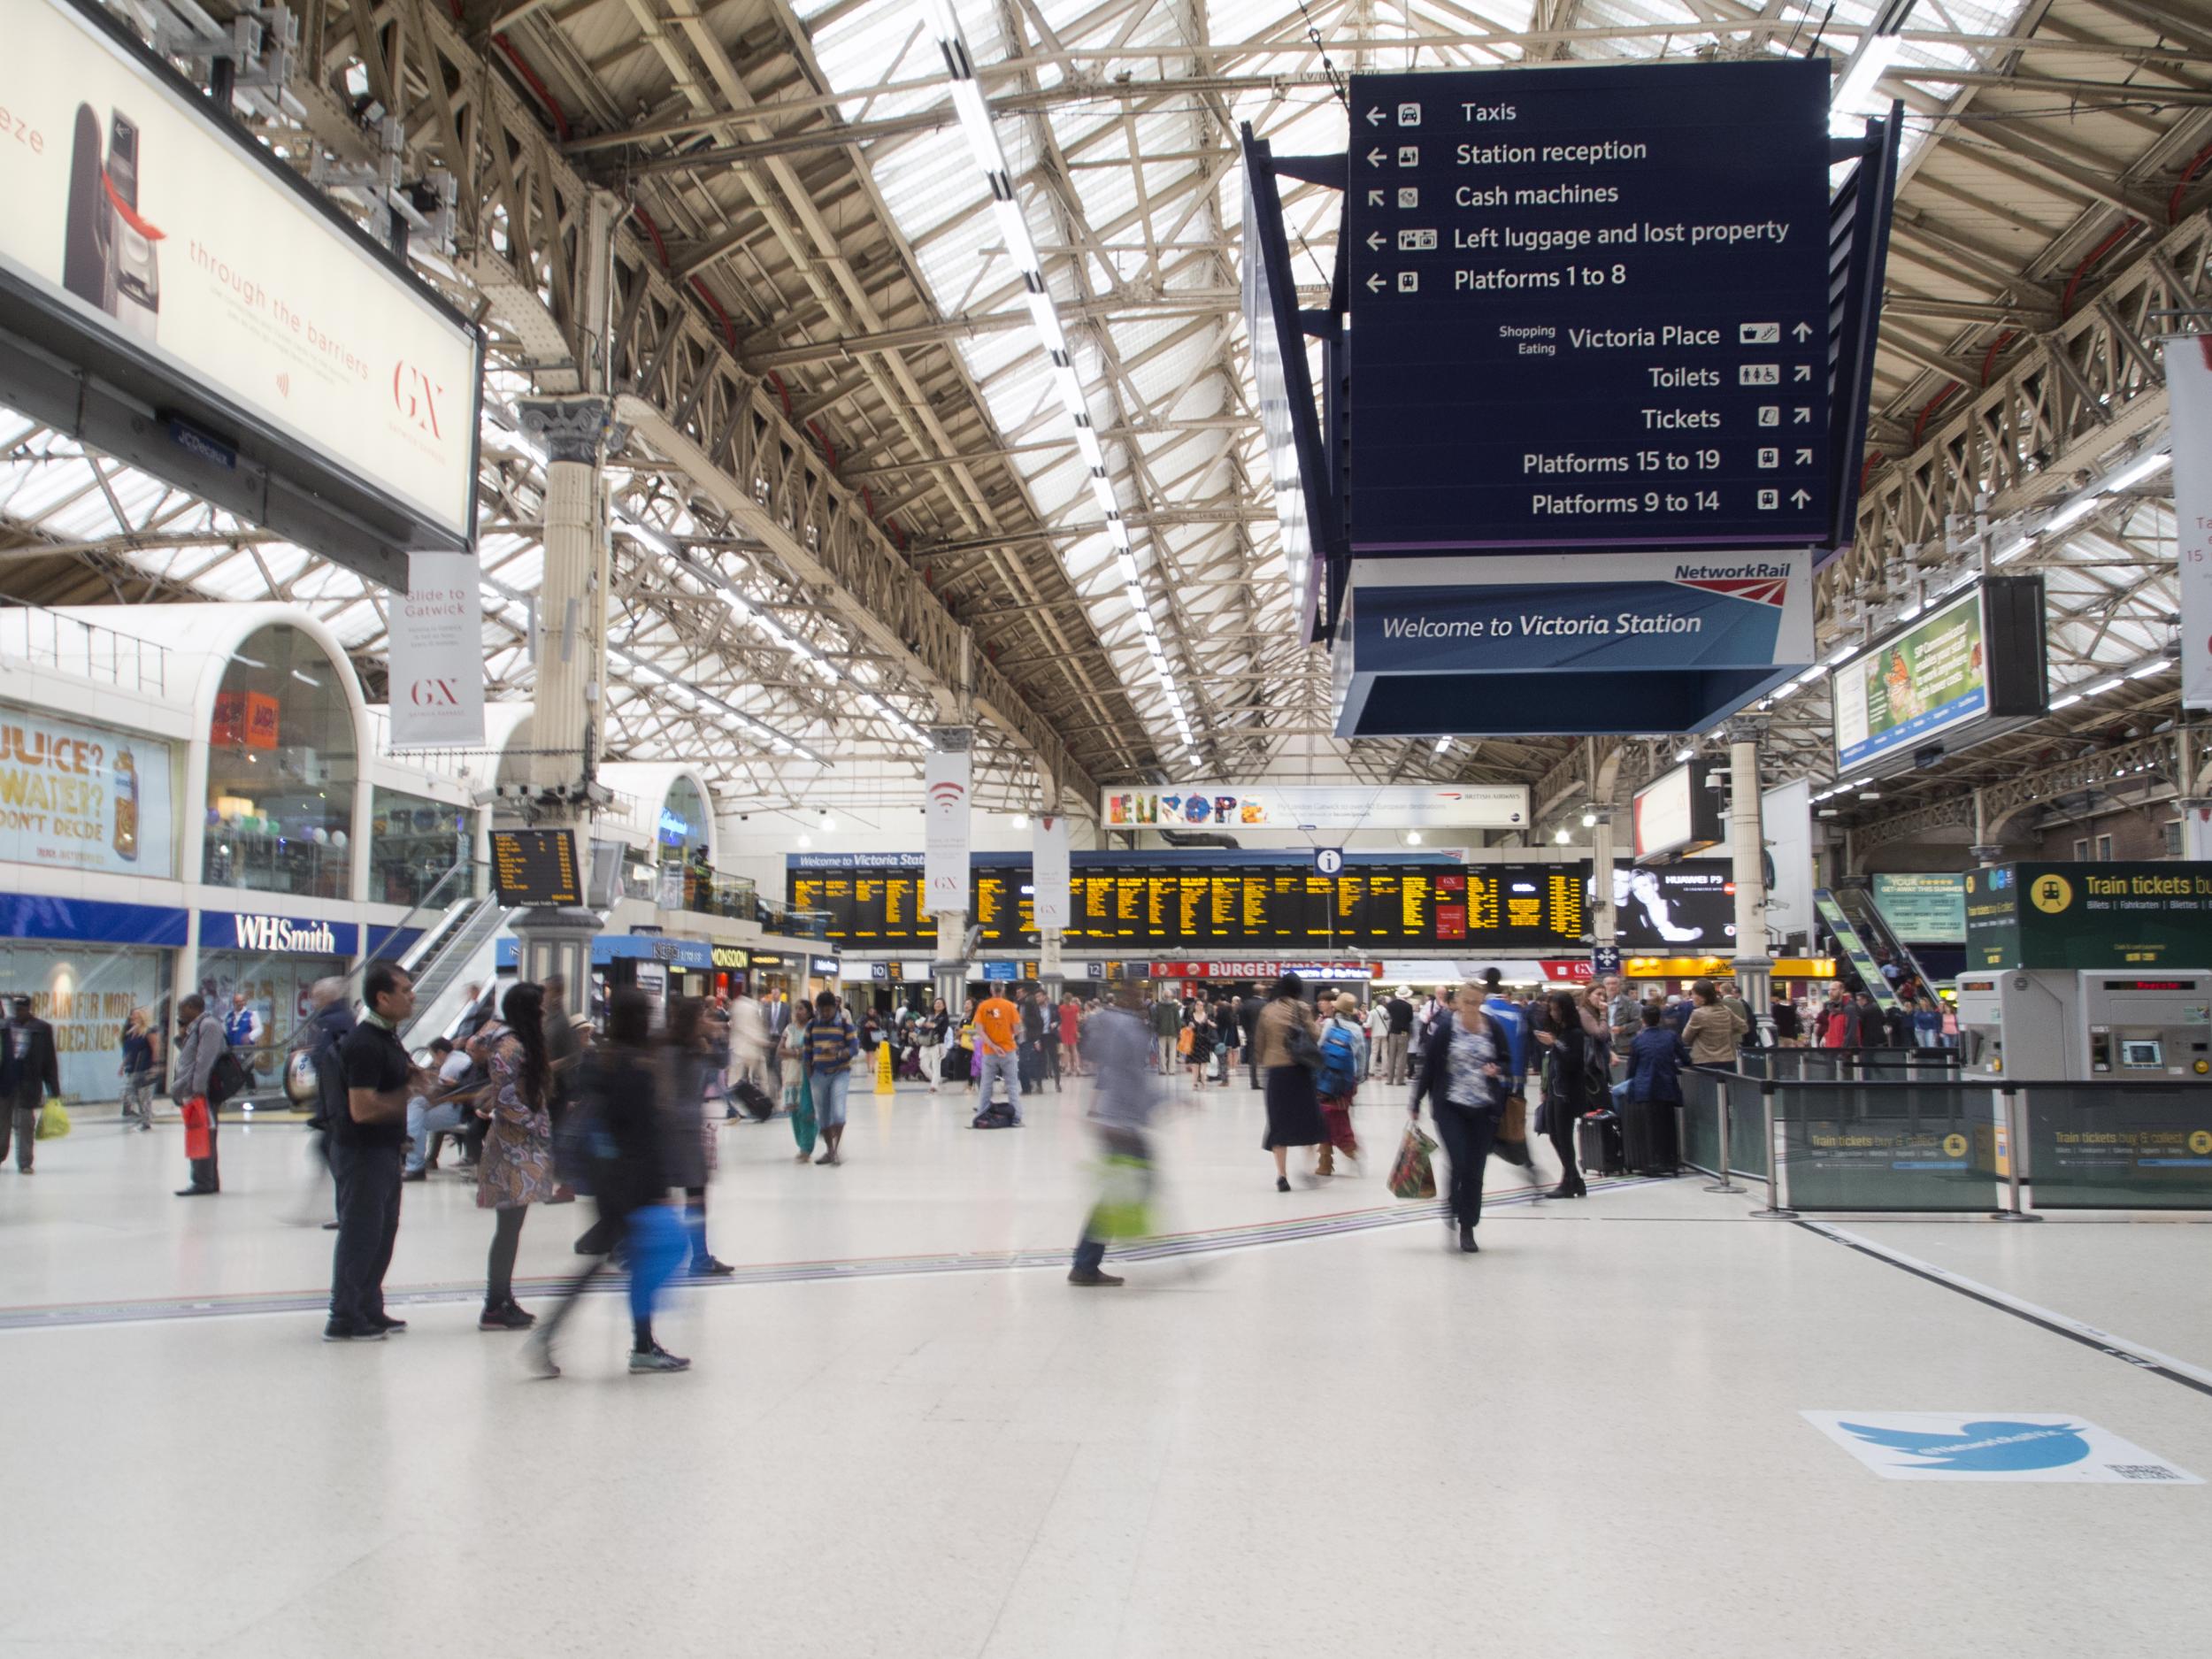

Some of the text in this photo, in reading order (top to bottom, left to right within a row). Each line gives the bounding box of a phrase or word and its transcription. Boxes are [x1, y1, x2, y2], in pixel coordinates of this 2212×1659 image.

[1462, 103, 1517, 122] Taxis
[1456, 140, 1647, 165] Station reception
[1455, 182, 1619, 207] Cash machines
[1455, 219, 1790, 253] Left luggage and lost property
[1455, 264, 1626, 290] Platforms 1 to 8
[189, 240, 266, 310] through
[273, 298, 301, 333] the
[307, 319, 369, 381] barriers
[1499, 325, 1720, 349] Shopping Victoria Place
[1518, 342, 1555, 356] Eating
[1647, 366, 1720, 388] Toilets
[1641, 408, 1721, 429] Tickets
[1524, 449, 1720, 474] Platforms 15 to 19
[1532, 489, 1720, 515] Platforms 9 to 14
[2187, 549, 2203, 563] 15
[405, 588, 465, 603] Glide to
[404, 603, 465, 618] Gatwick
[1383, 612, 1701, 639] Welcome to Victoria Station
[1110, 793, 1263, 825] EUROPE
[800, 856, 840, 866] Welcome
[842, 856, 852, 866] to
[854, 854, 898, 866] Victoria
[1664, 875, 1723, 885] HUAWEI P9
[2085, 875, 2128, 895] Train
[2131, 875, 2192, 895] tickets
[234, 914, 334, 953] WHSmith
[710, 948, 749, 969] MONSOON
[872, 965, 885, 977] 10
[1089, 964, 1100, 975] 12
[1209, 962, 1278, 977] BURGER
[1811, 1135, 1835, 1147] Train
[1839, 1135, 1873, 1147] tickets
[2055, 1132, 2078, 1143] Train
[2082, 1132, 2116, 1143] tickets
